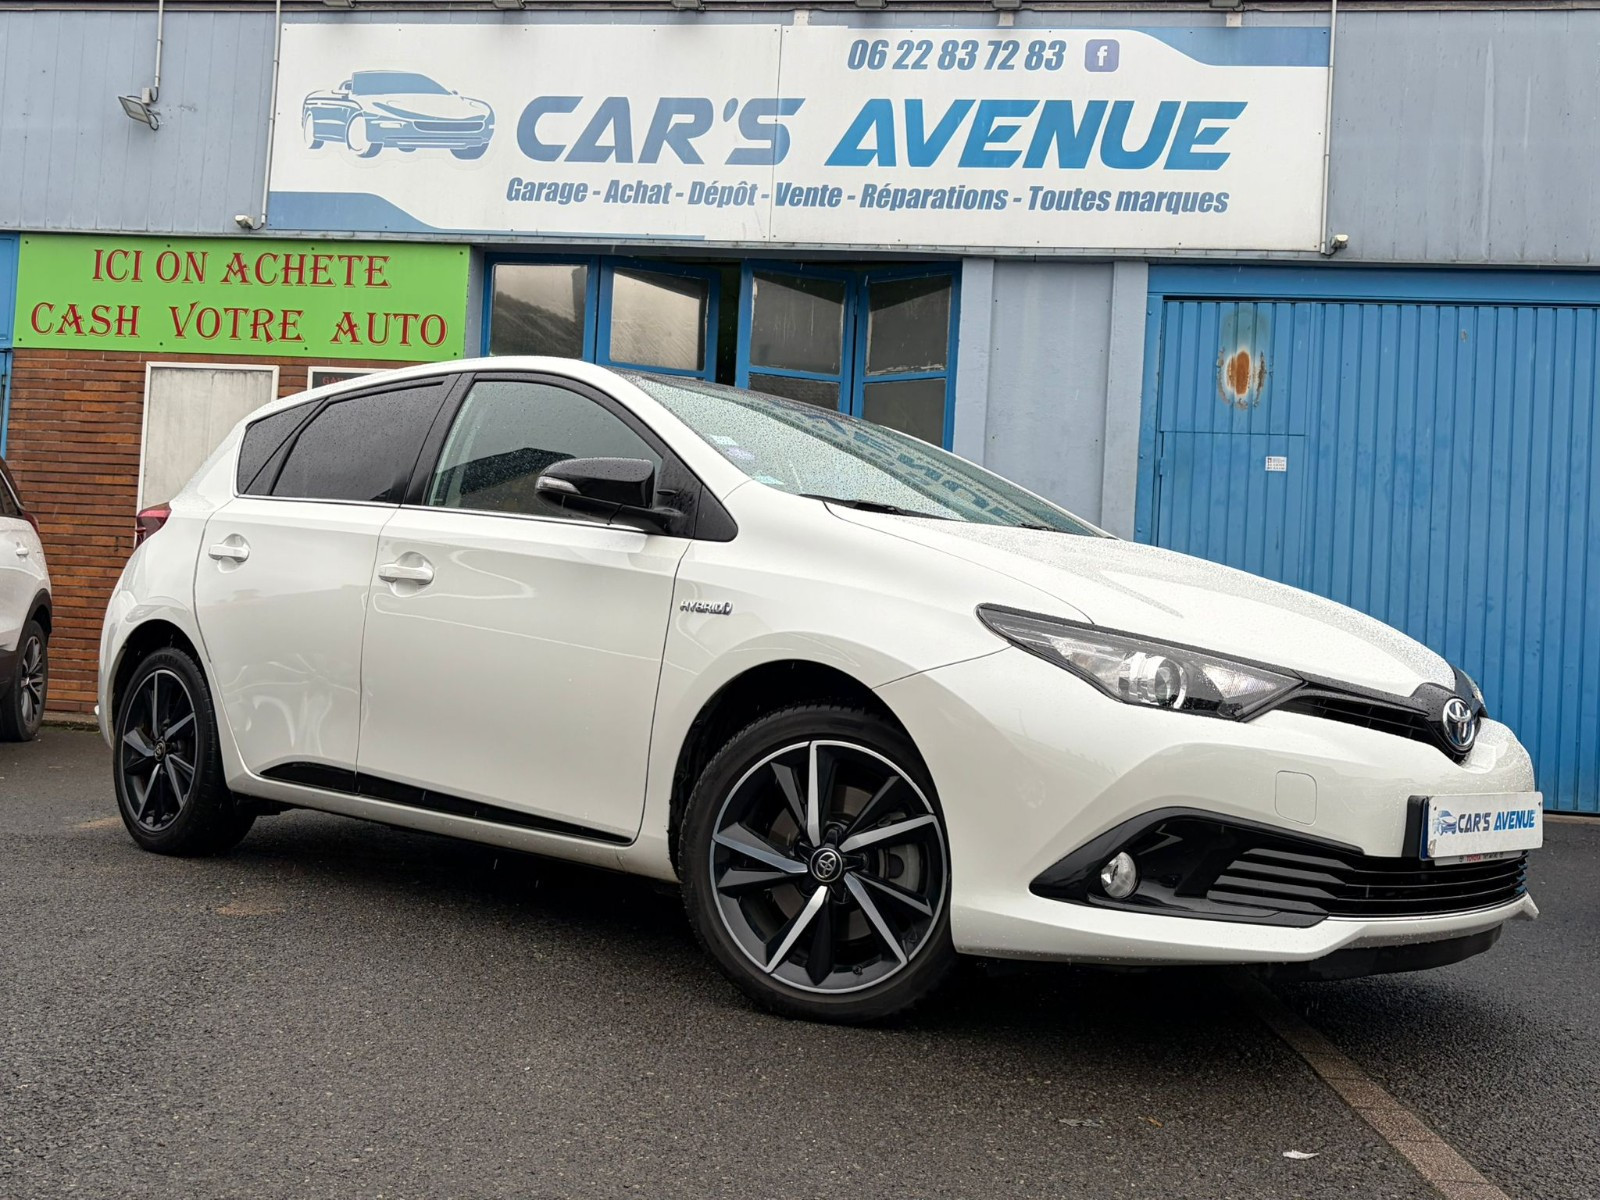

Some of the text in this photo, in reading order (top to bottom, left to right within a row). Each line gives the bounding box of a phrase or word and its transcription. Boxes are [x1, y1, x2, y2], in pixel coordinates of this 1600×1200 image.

[847, 40, 1067, 71] 06 22 83 72 83
[516, 96, 1249, 171] CAR'S AVENUE
[506, 177, 588, 206] Garage
[604, 179, 672, 205] Achat
[688, 180, 757, 208] Dépôt
[774, 182, 843, 208] Vente
[860, 183, 1009, 211] Réparations
[1028, 186, 1111, 212] Toutes
[1115, 190, 1230, 215] marques
[92, 249, 392, 288] ICI ON ACHETE
[31, 300, 448, 347] CASH VOTRE AUTO
[1457, 810, 1537, 834] CAR'S AVENUE
